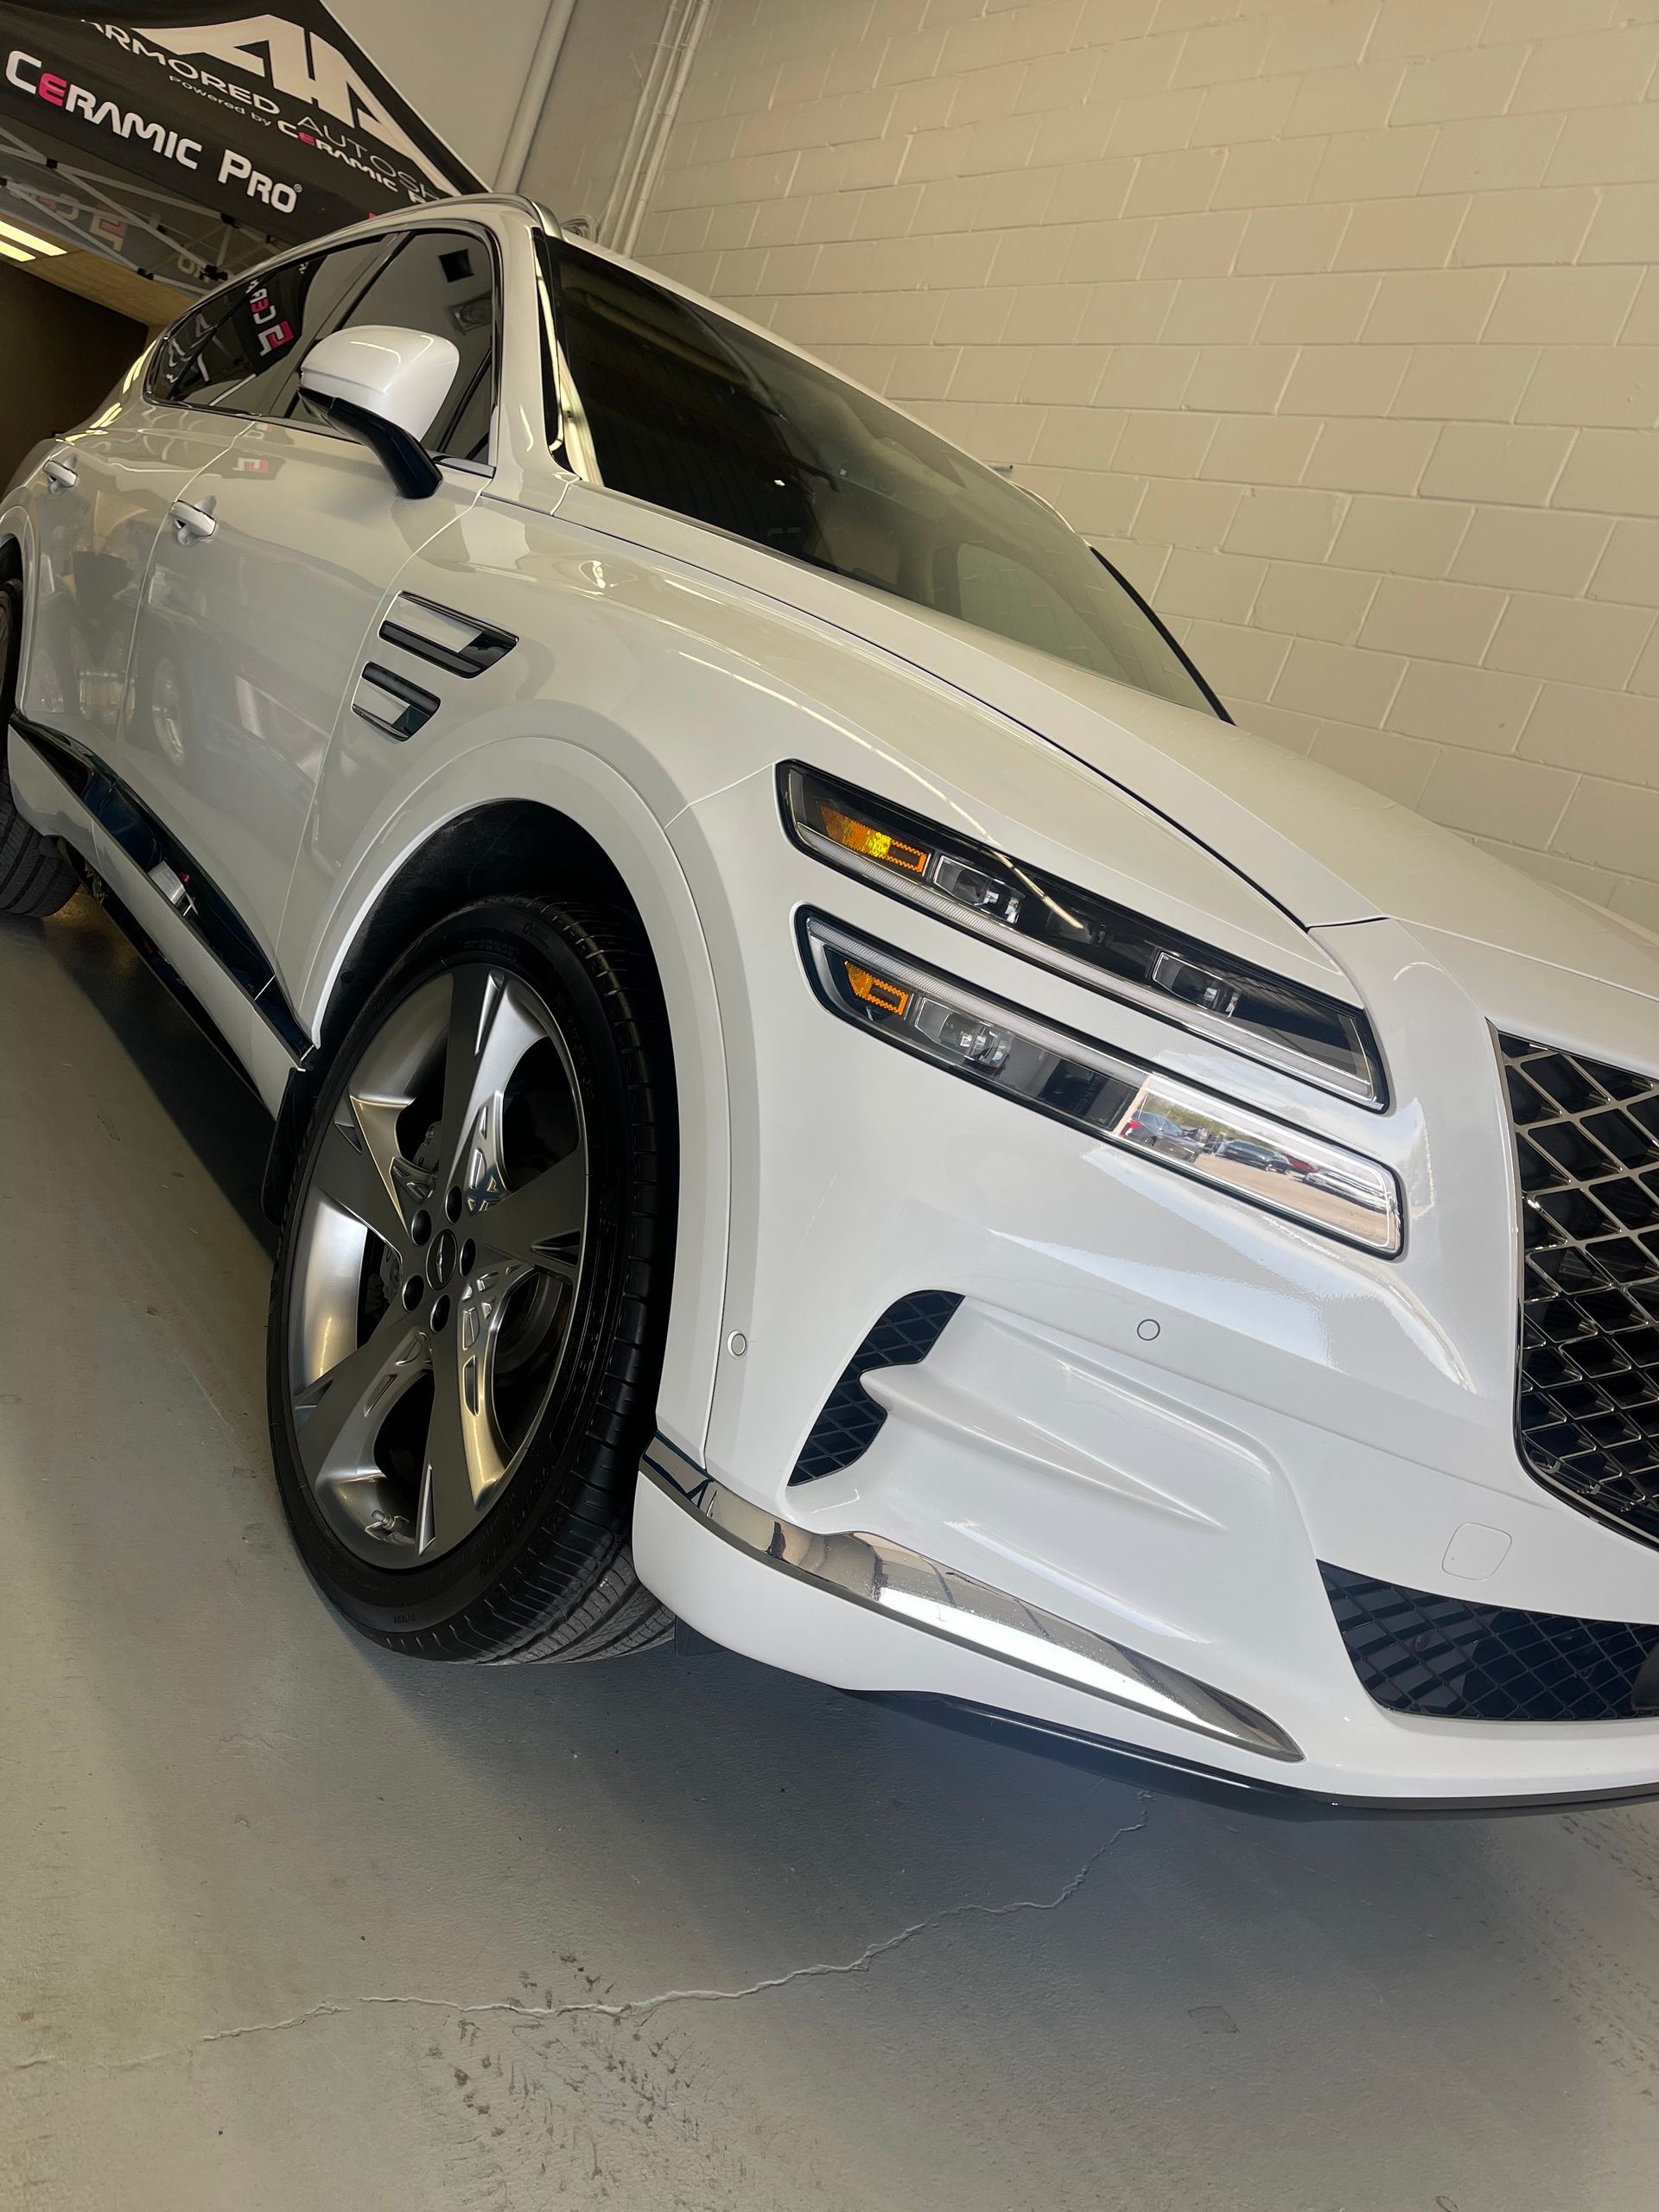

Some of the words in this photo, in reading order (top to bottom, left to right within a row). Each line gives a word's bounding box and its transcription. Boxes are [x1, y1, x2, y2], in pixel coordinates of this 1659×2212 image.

[5, 50, 202, 170] CERAMIC
[168, 75, 245, 115] Powered
[251, 112, 272, 126] by
[276, 120, 399, 193] CERAMIC
